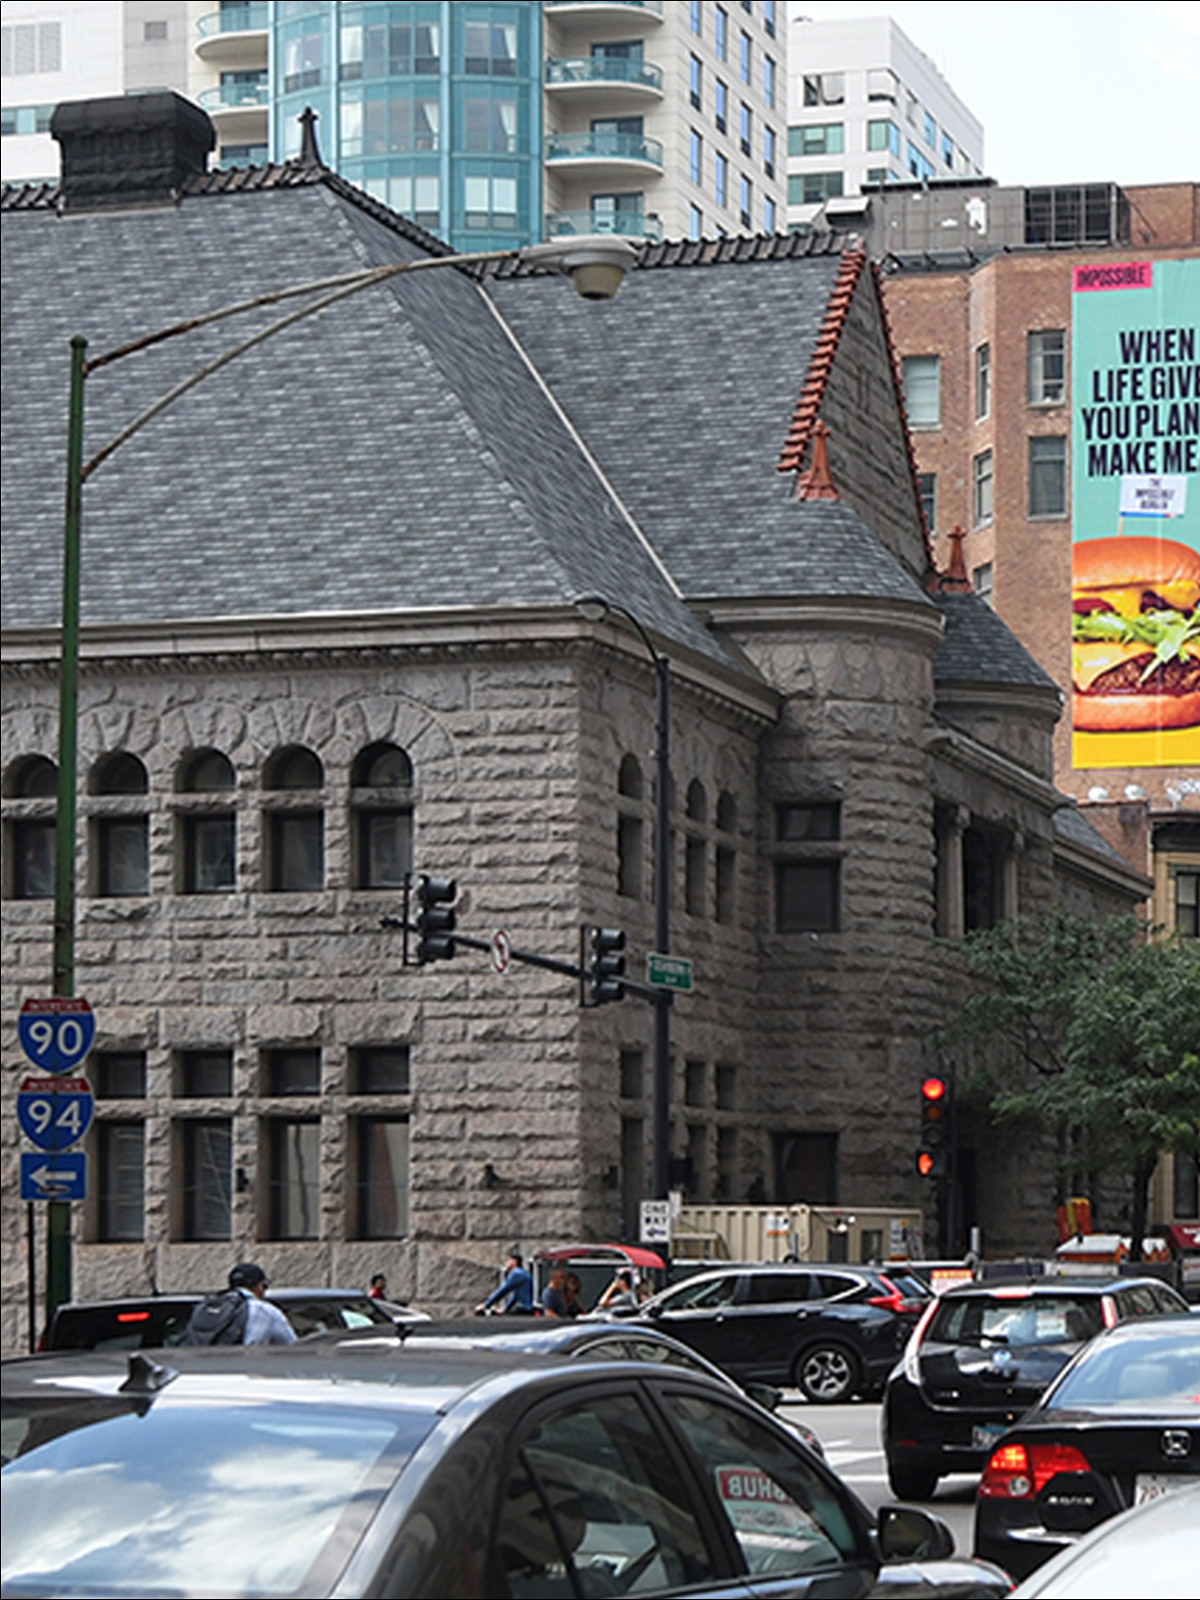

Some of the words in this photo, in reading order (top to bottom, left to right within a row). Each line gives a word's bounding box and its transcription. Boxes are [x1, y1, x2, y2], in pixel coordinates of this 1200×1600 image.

[1077, 266, 1146, 288] IMPOSSIBLE
[1119, 328, 1194, 364] WHEN
[1093, 368, 1145, 403] LIFE
[1081, 405, 1130, 441] YOU
[1088, 441, 1157, 477] MAKE
[29, 1020, 83, 1056] 90
[28, 1099, 82, 1136] 94
[643, 1204, 667, 1214] ONE
